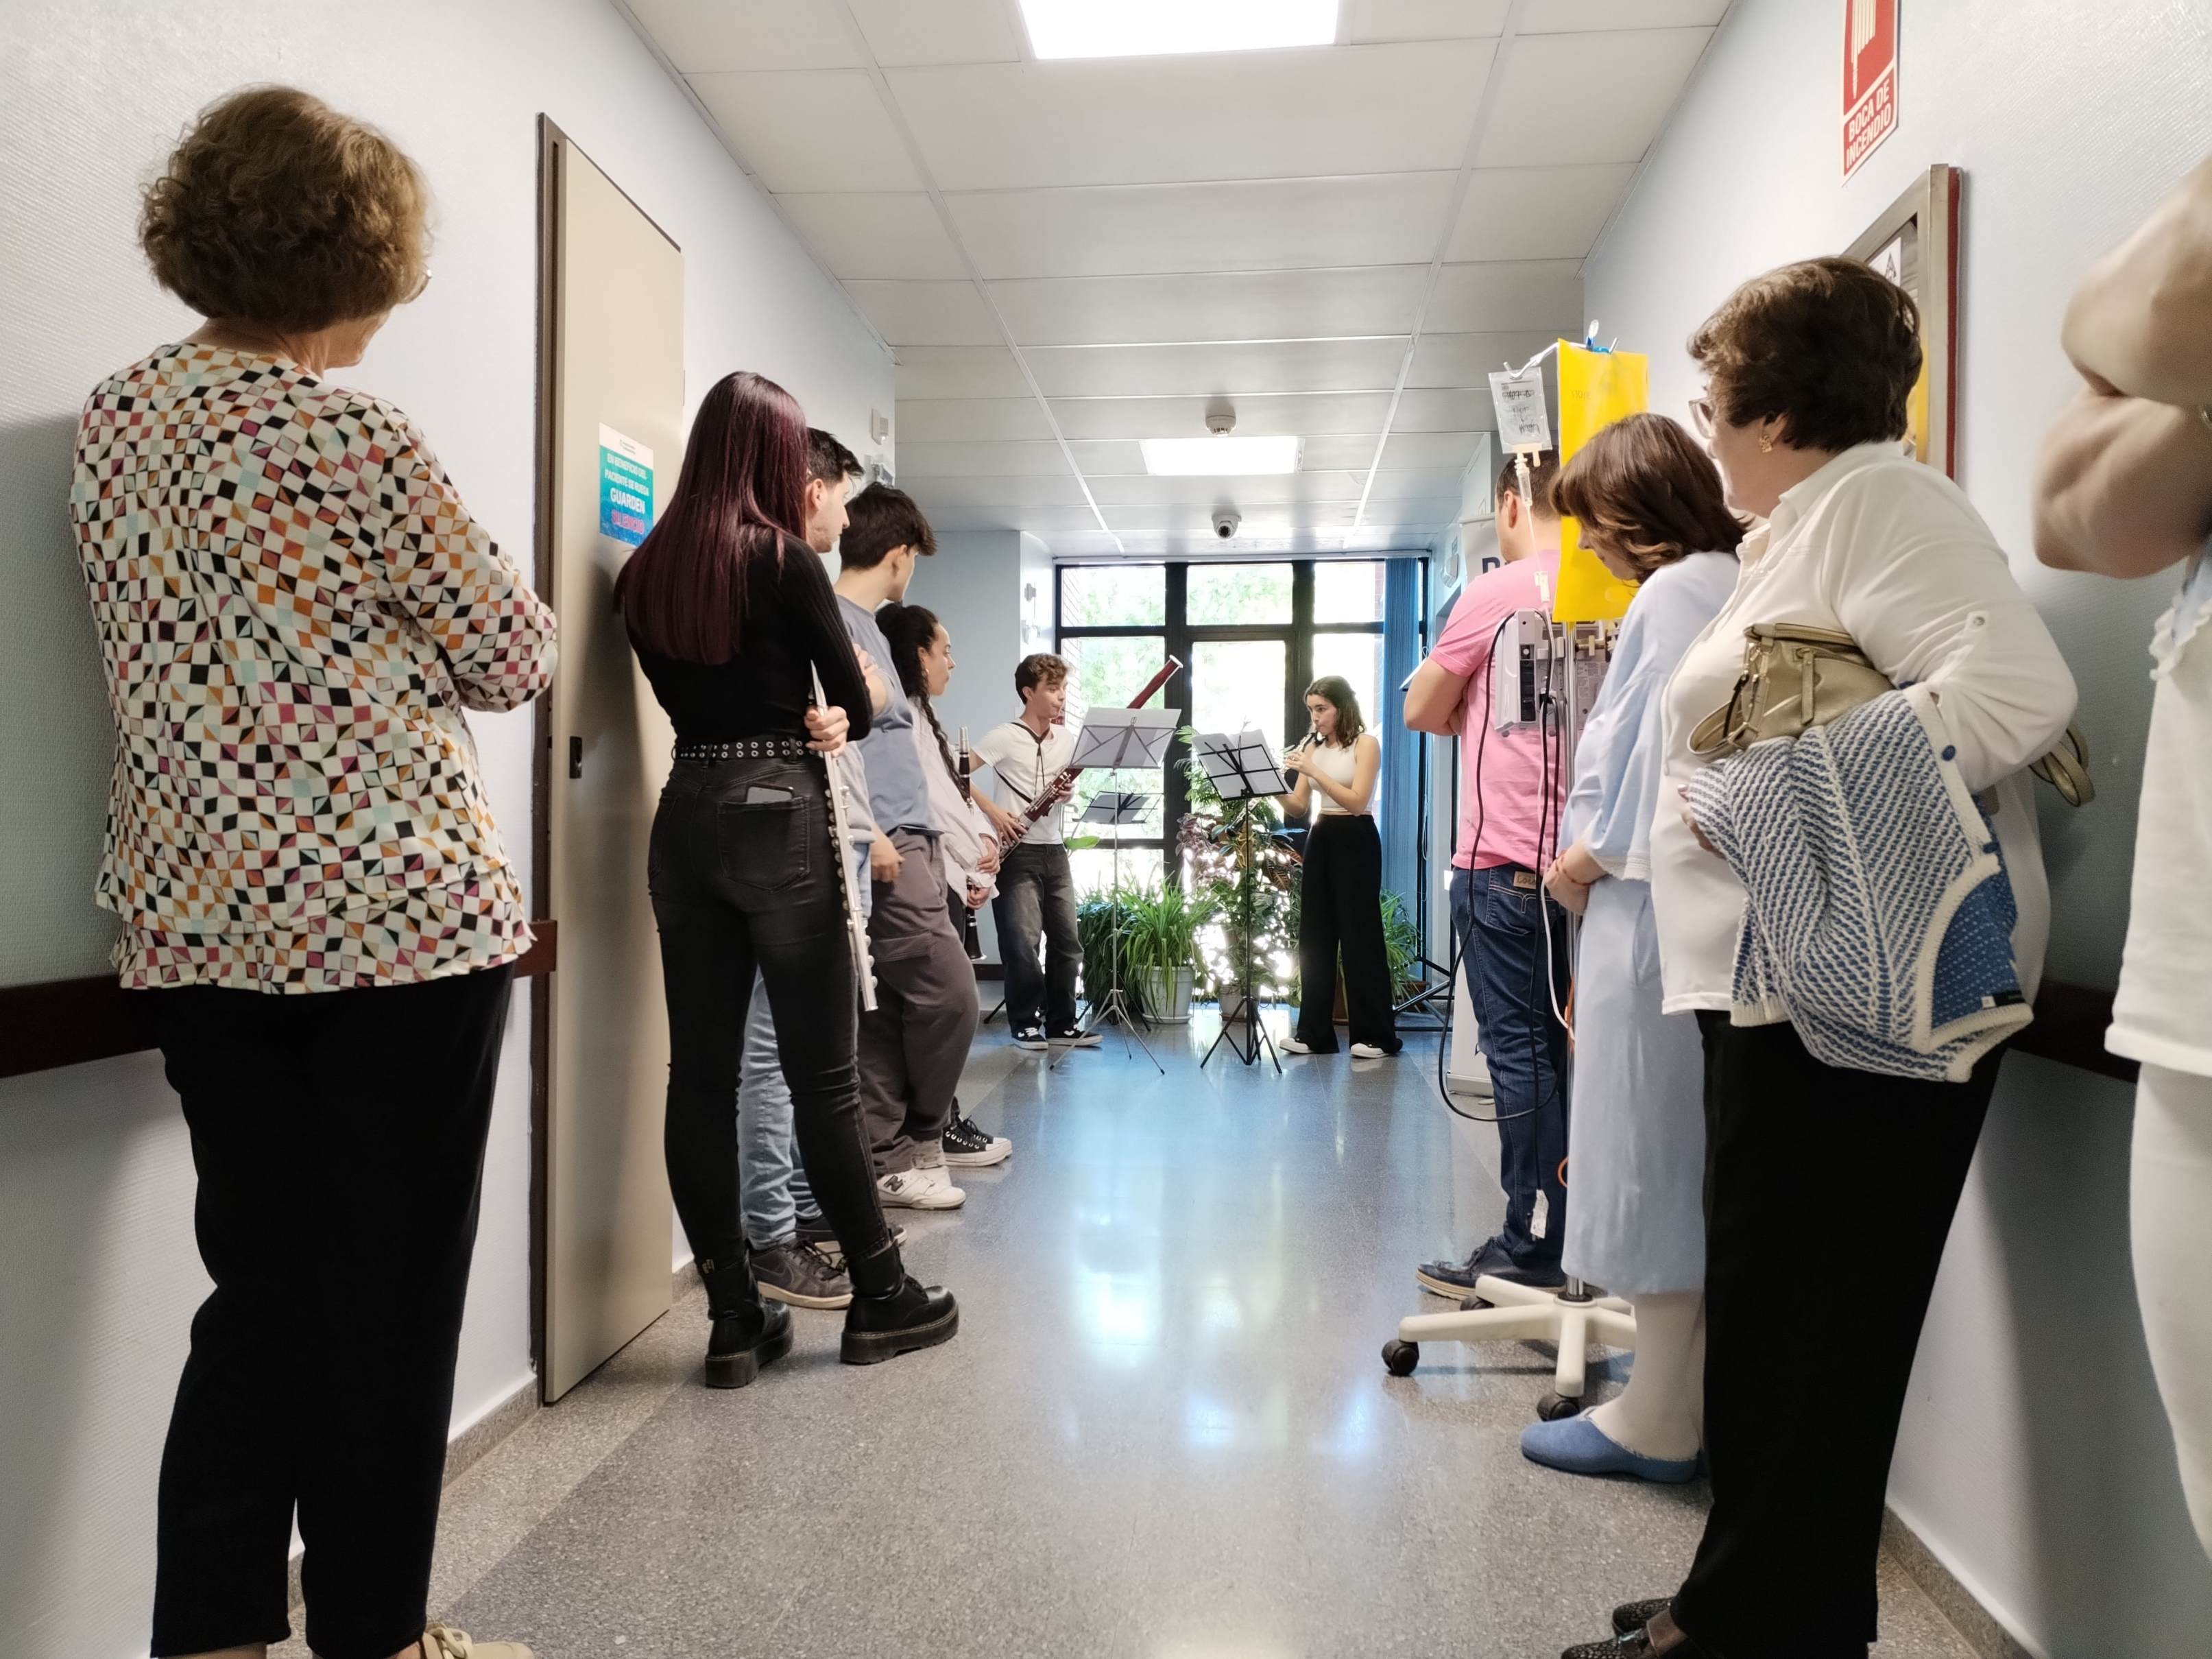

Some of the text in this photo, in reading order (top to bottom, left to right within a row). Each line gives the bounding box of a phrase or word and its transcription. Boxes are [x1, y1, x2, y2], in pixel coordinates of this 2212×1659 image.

[1849, 78, 1890, 143] BOCA DE
[1846, 102, 1891, 169] INCENDIO
[610, 487, 645, 514] GUARDEN
[611, 508, 645, 535] SILENCIO
